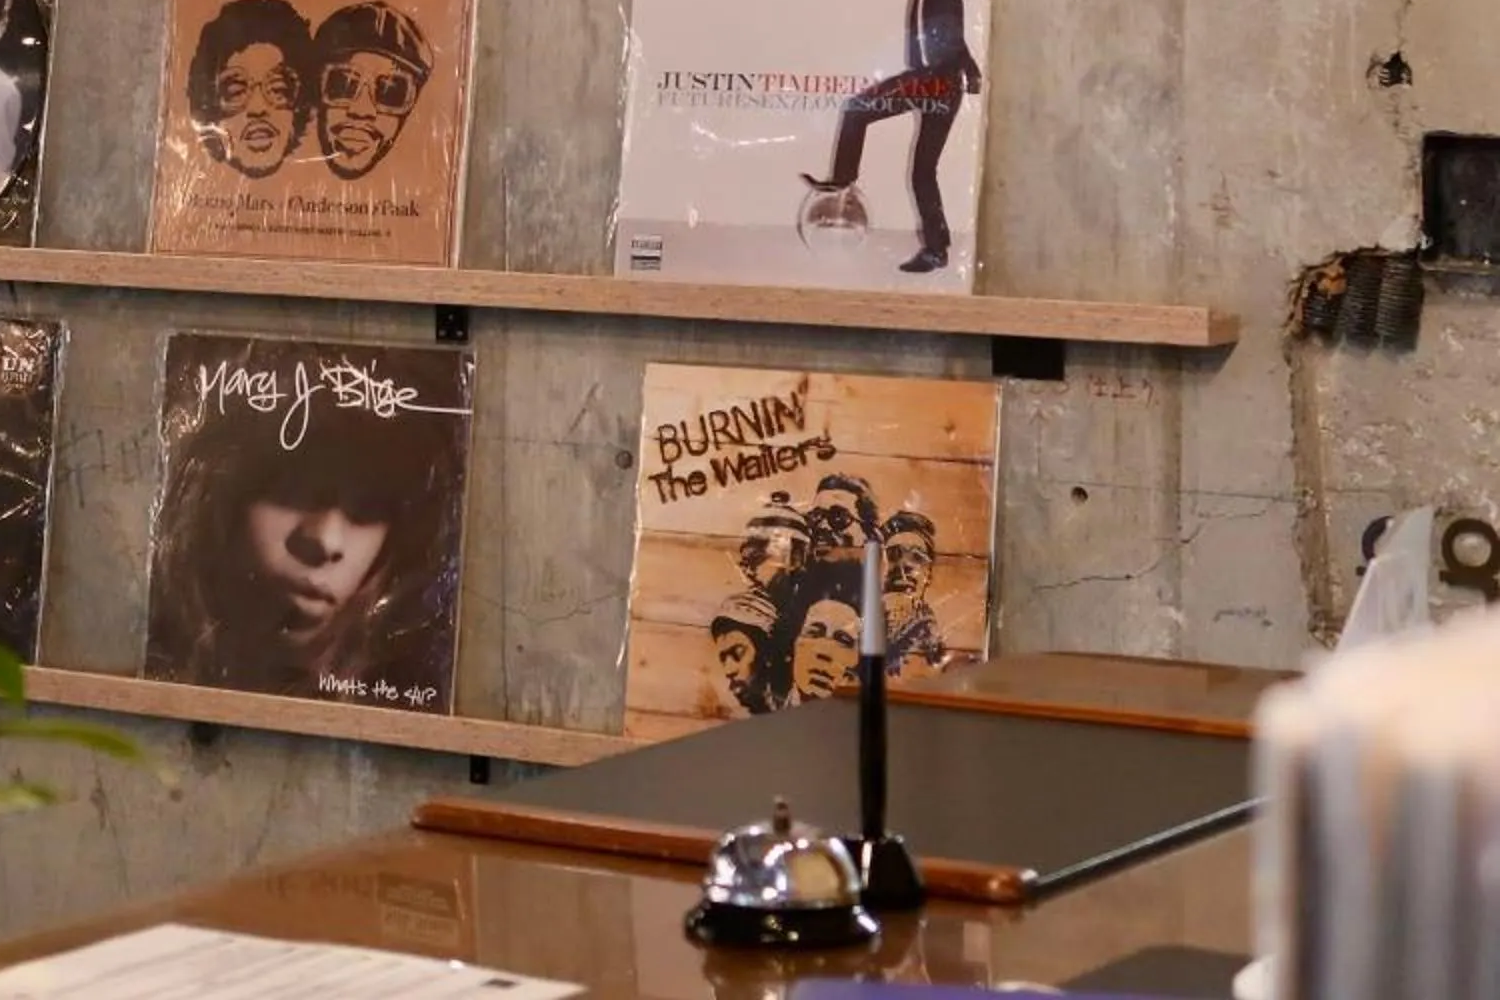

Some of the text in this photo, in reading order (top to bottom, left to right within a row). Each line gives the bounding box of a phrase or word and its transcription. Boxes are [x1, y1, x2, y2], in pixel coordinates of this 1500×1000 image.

[657, 71, 951, 98] JUSTIN TIMBERAKE
[197, 357, 474, 451] Mary J Blige
[648, 431, 838, 505] The Wailers
